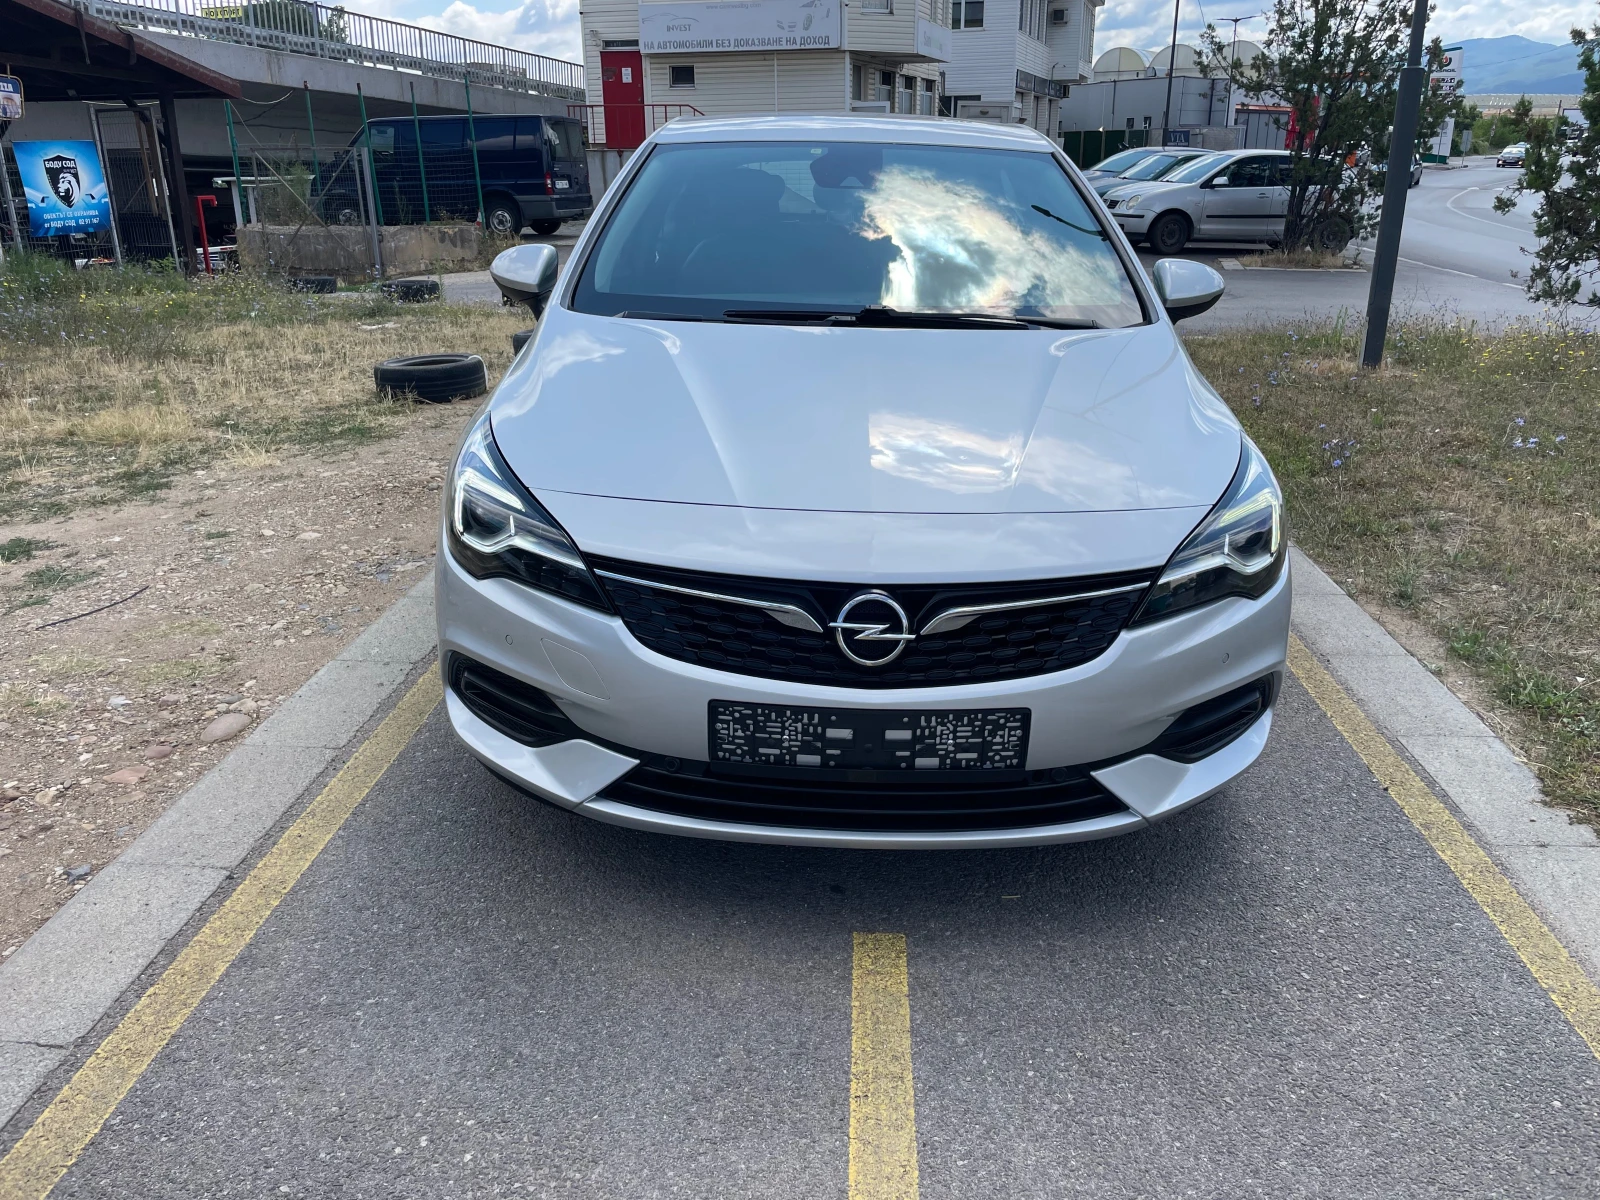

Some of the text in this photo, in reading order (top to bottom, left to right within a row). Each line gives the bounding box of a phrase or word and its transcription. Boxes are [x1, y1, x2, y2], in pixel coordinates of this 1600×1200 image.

[666, 24, 692, 32] INVEST
[643, 35, 830, 50] НА АВТОМОБИЛИ БЕЗ ДОКАЗВАНЕ НА ДОХОД
